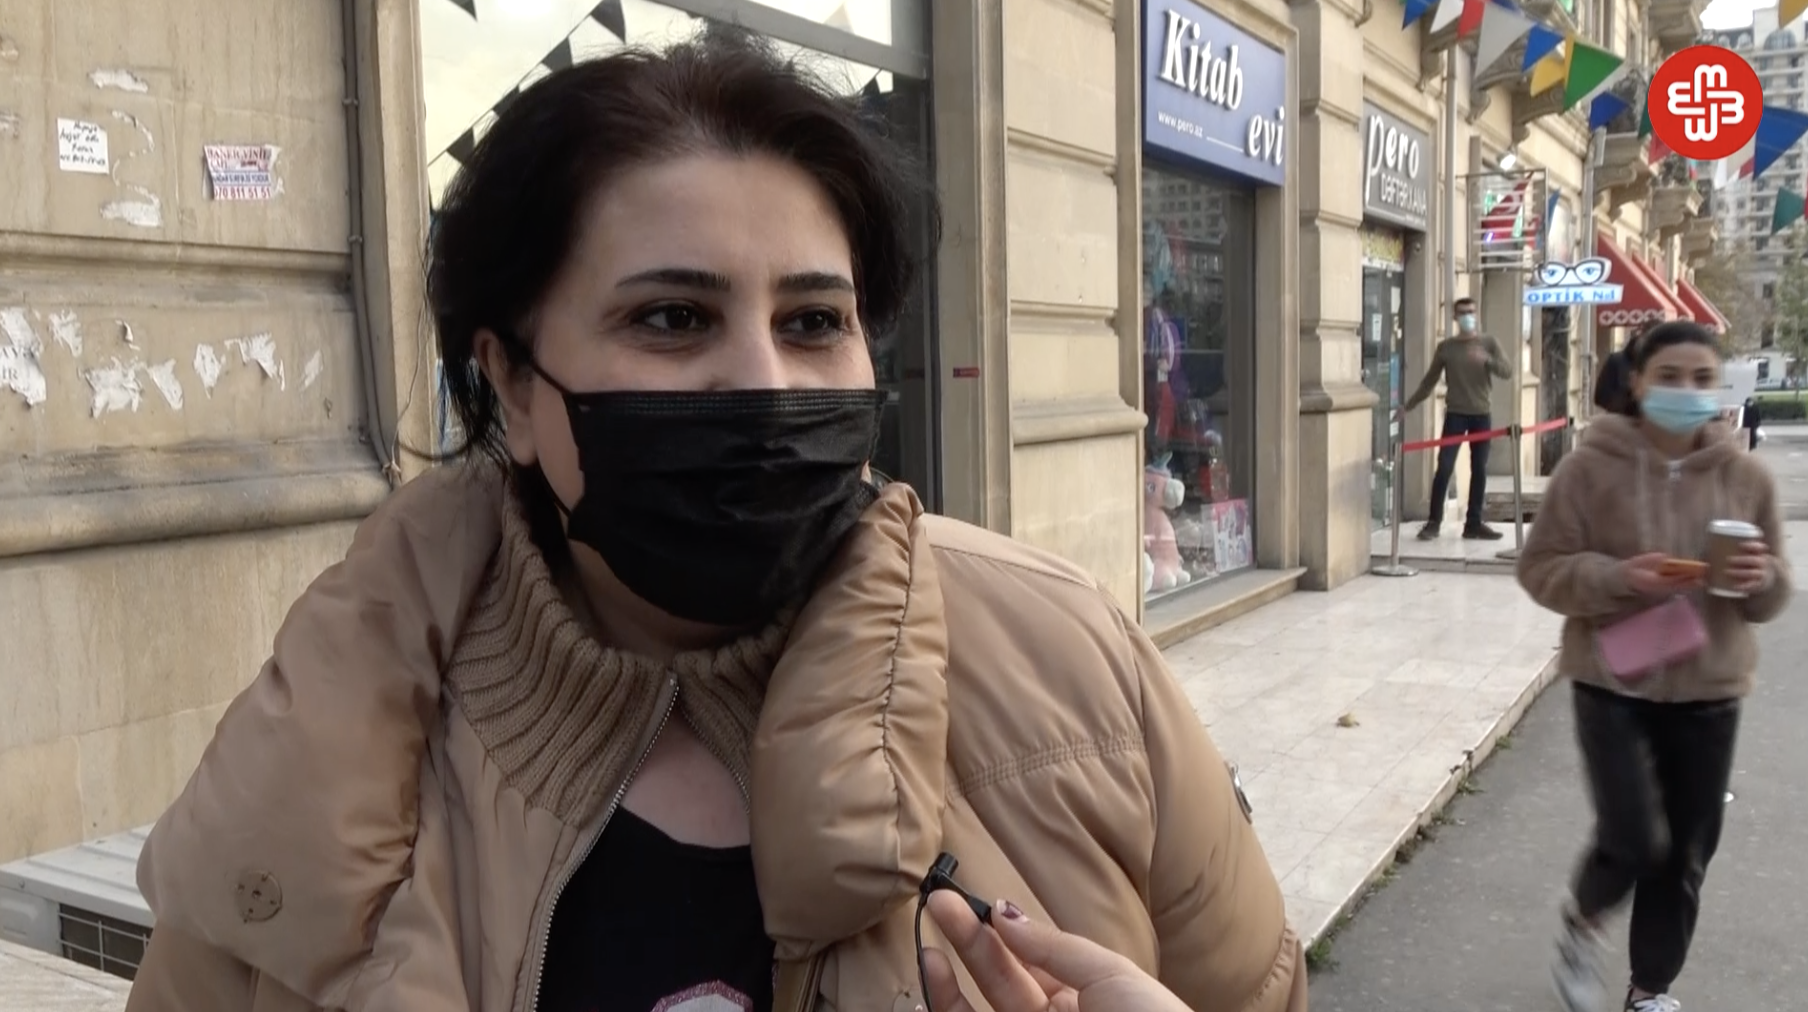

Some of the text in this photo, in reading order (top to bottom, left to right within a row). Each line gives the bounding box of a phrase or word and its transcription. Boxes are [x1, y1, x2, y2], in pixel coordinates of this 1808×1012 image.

[1161, 9, 1243, 110] Kitab
[1158, 111, 1203, 138] www.pero.az
[1249, 106, 1285, 165] evi
[1365, 115, 1420, 204] pero
